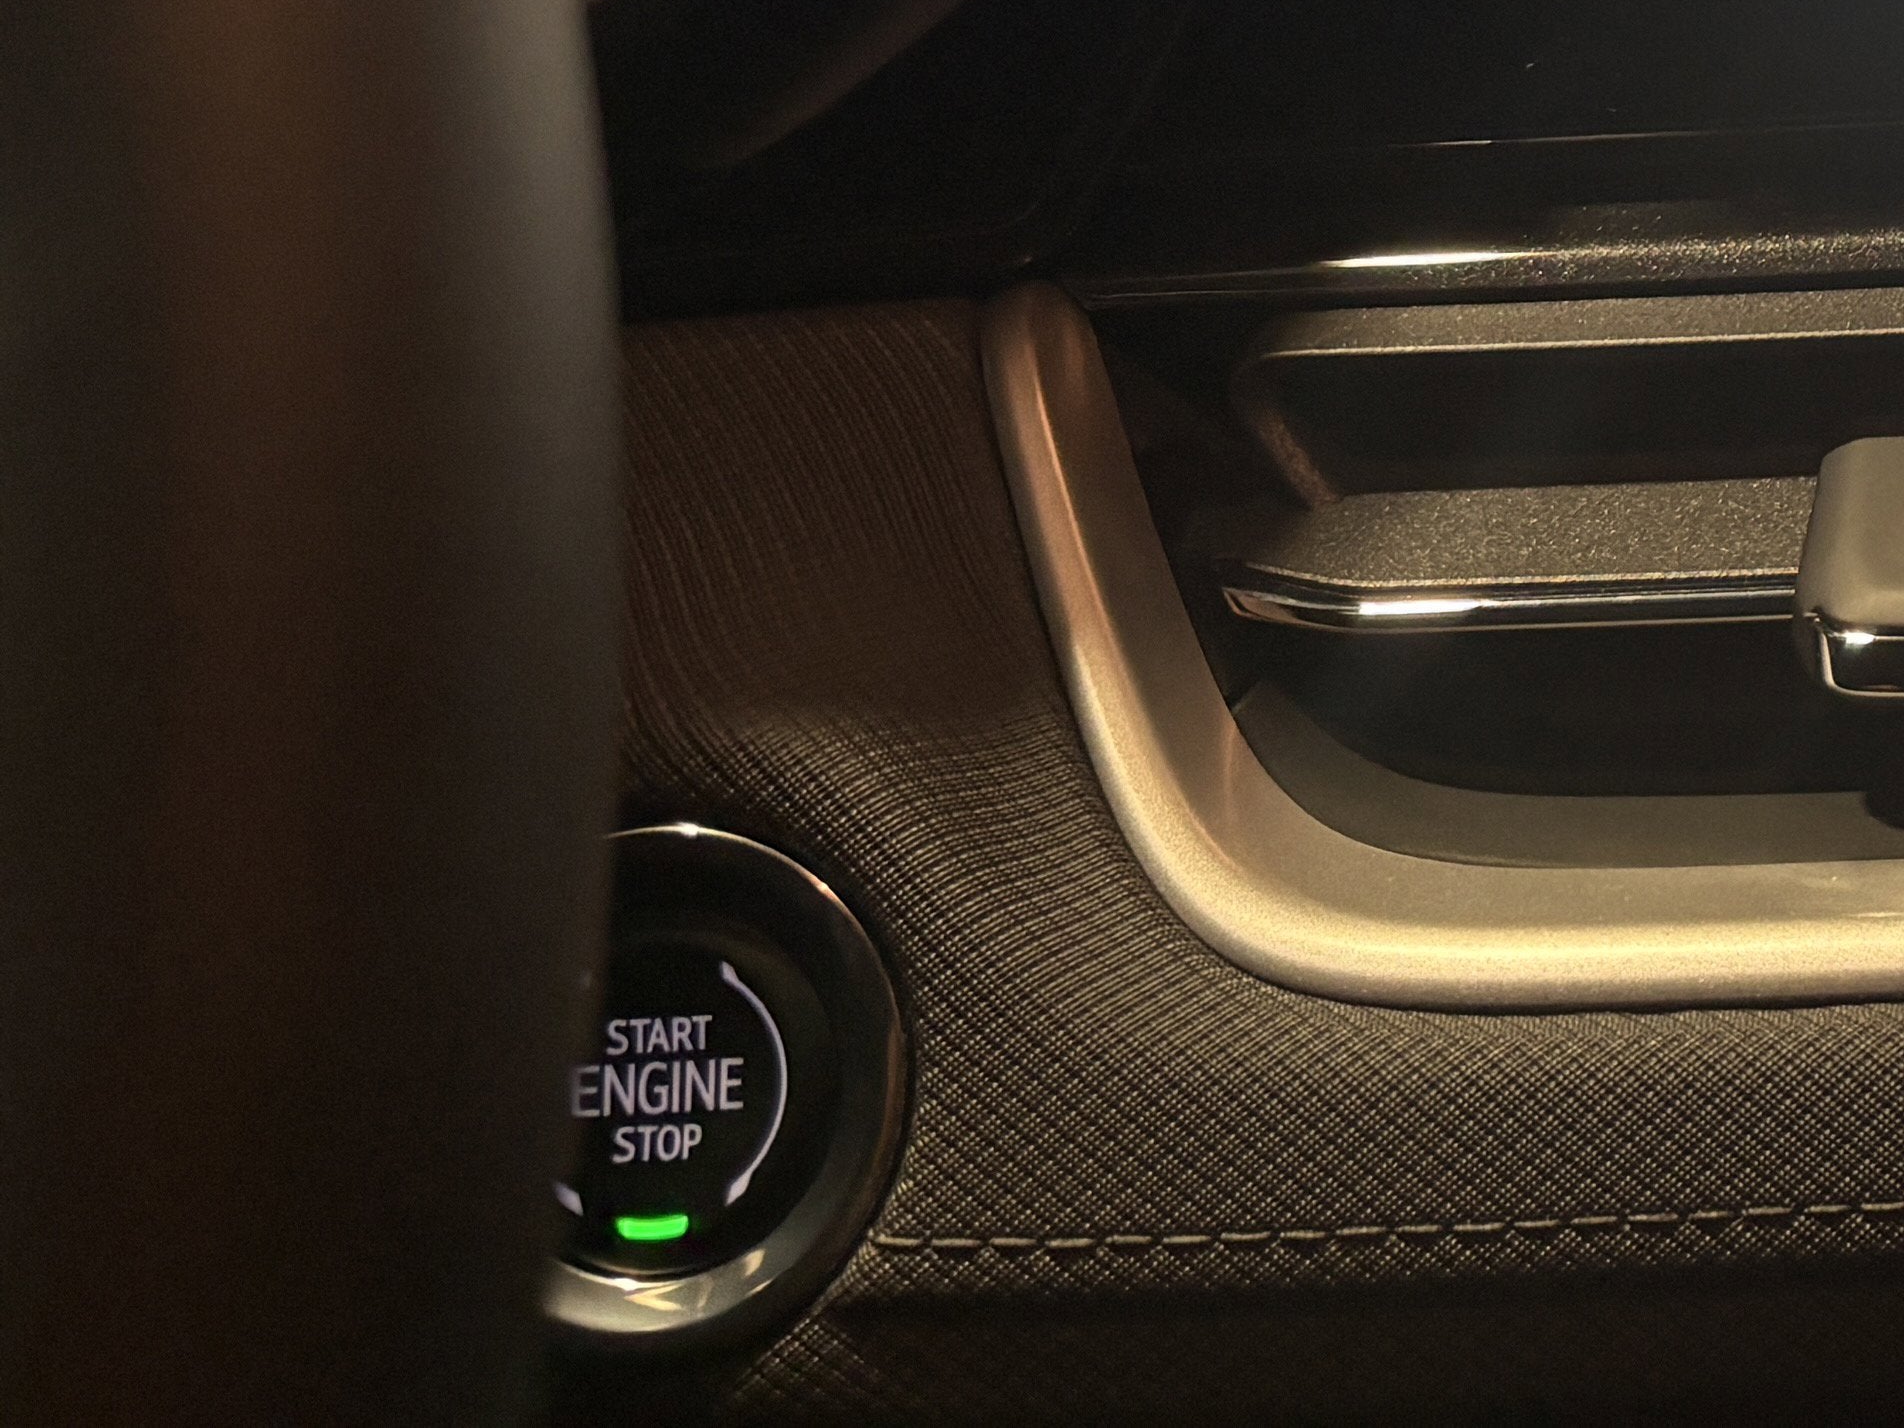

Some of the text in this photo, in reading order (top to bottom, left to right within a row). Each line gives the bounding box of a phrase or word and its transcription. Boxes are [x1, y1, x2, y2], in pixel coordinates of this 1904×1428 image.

[606, 1015, 712, 1056] START
[572, 1057, 744, 1118] ENGINE
[612, 1123, 702, 1164] STOP
